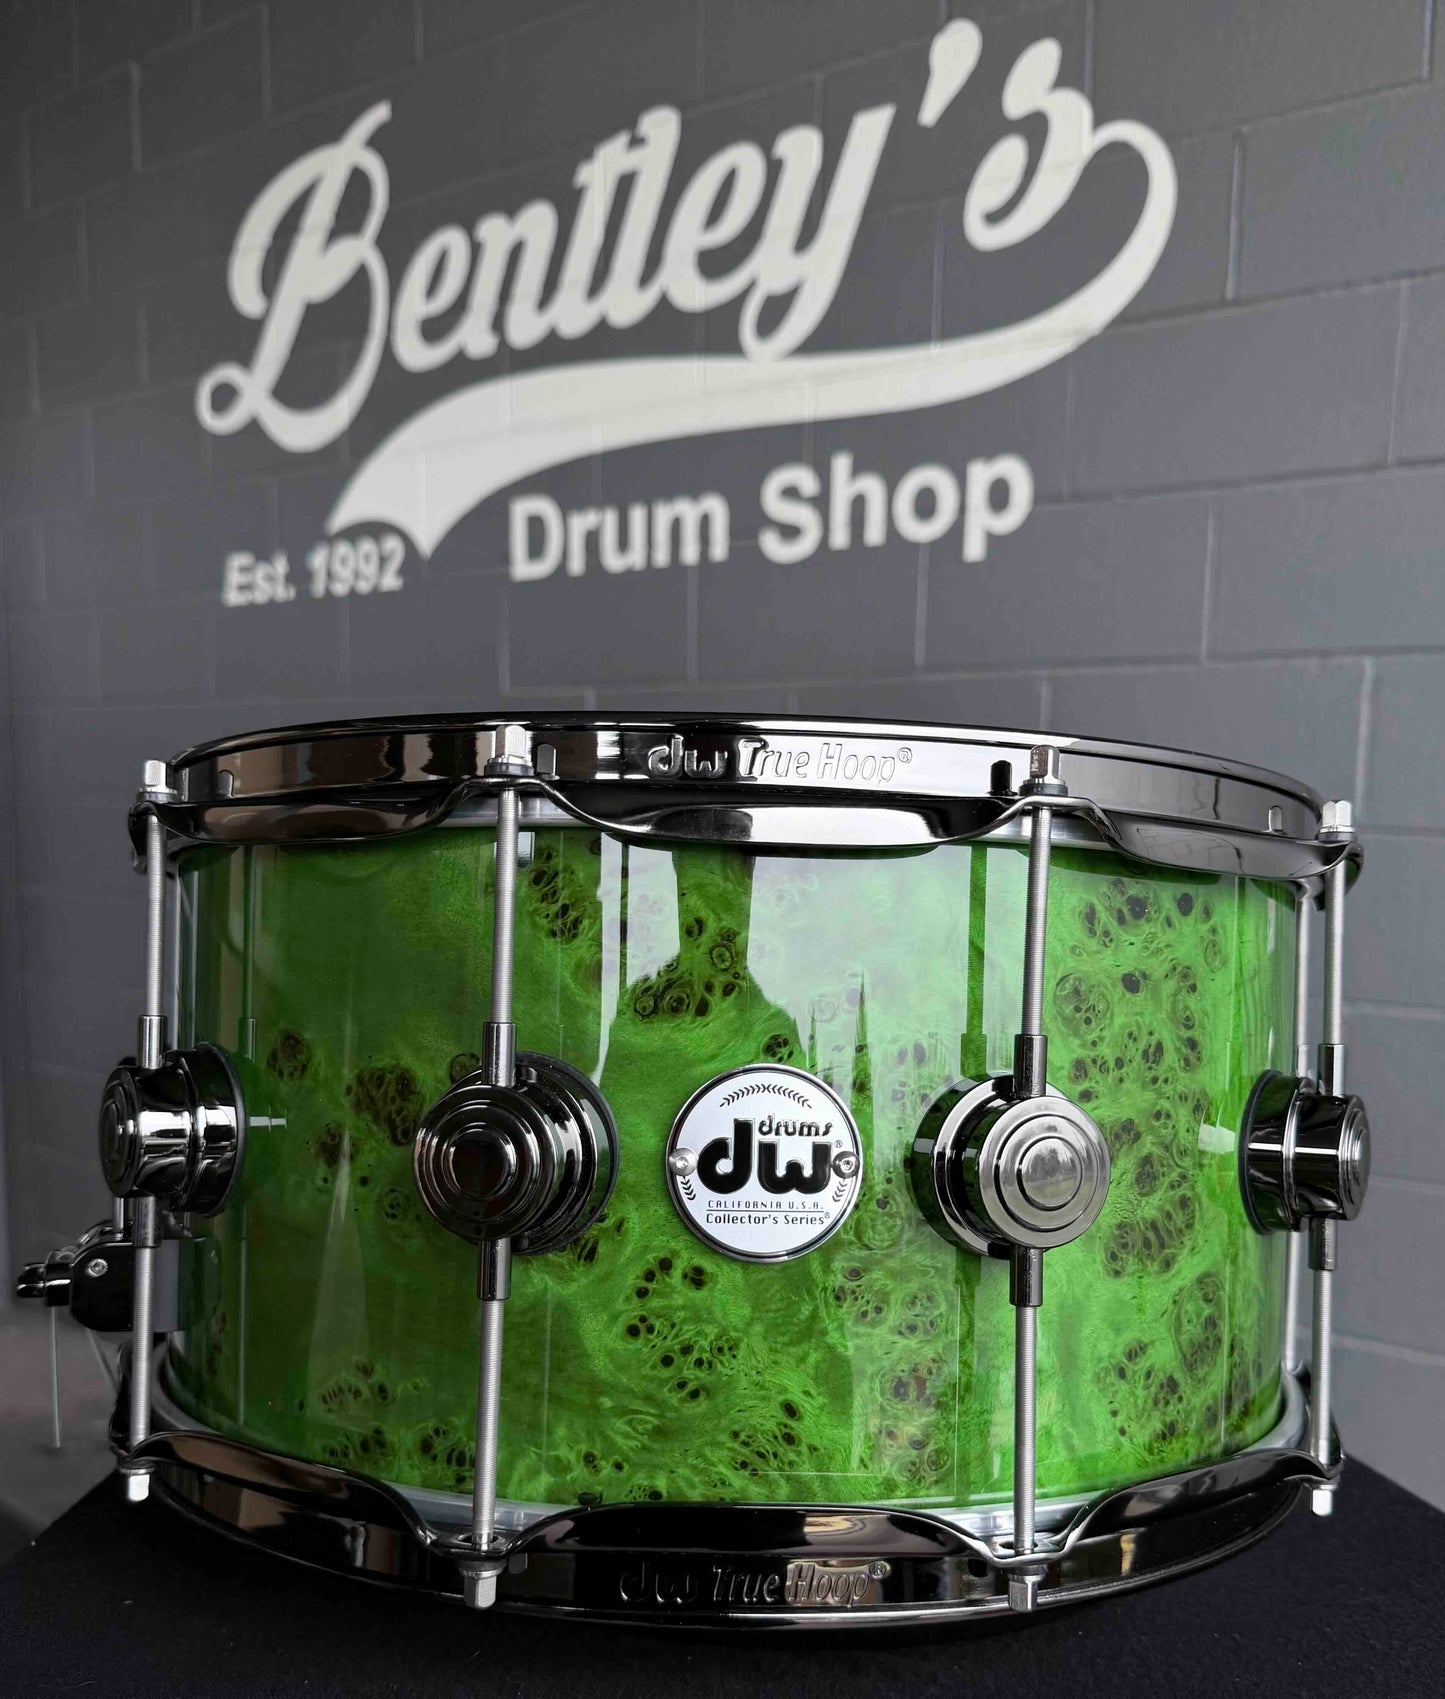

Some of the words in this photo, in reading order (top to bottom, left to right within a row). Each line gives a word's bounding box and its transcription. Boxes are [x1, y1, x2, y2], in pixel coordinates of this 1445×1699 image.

[197, 18, 1178, 453] Bentley's
[508, 488, 731, 582] Drum
[758, 450, 1036, 564] Shop
[221, 550, 297, 607] Est.
[308, 534, 405, 597] 1992
[736, 737, 812, 780] True
[758, 1113, 833, 1137] drums
[706, 1213, 779, 1225] Collector's
[708, 1200, 782, 1210] CALIFORNIA
[788, 1200, 825, 1210] U.S.A.
[712, 1564, 781, 1603] True
